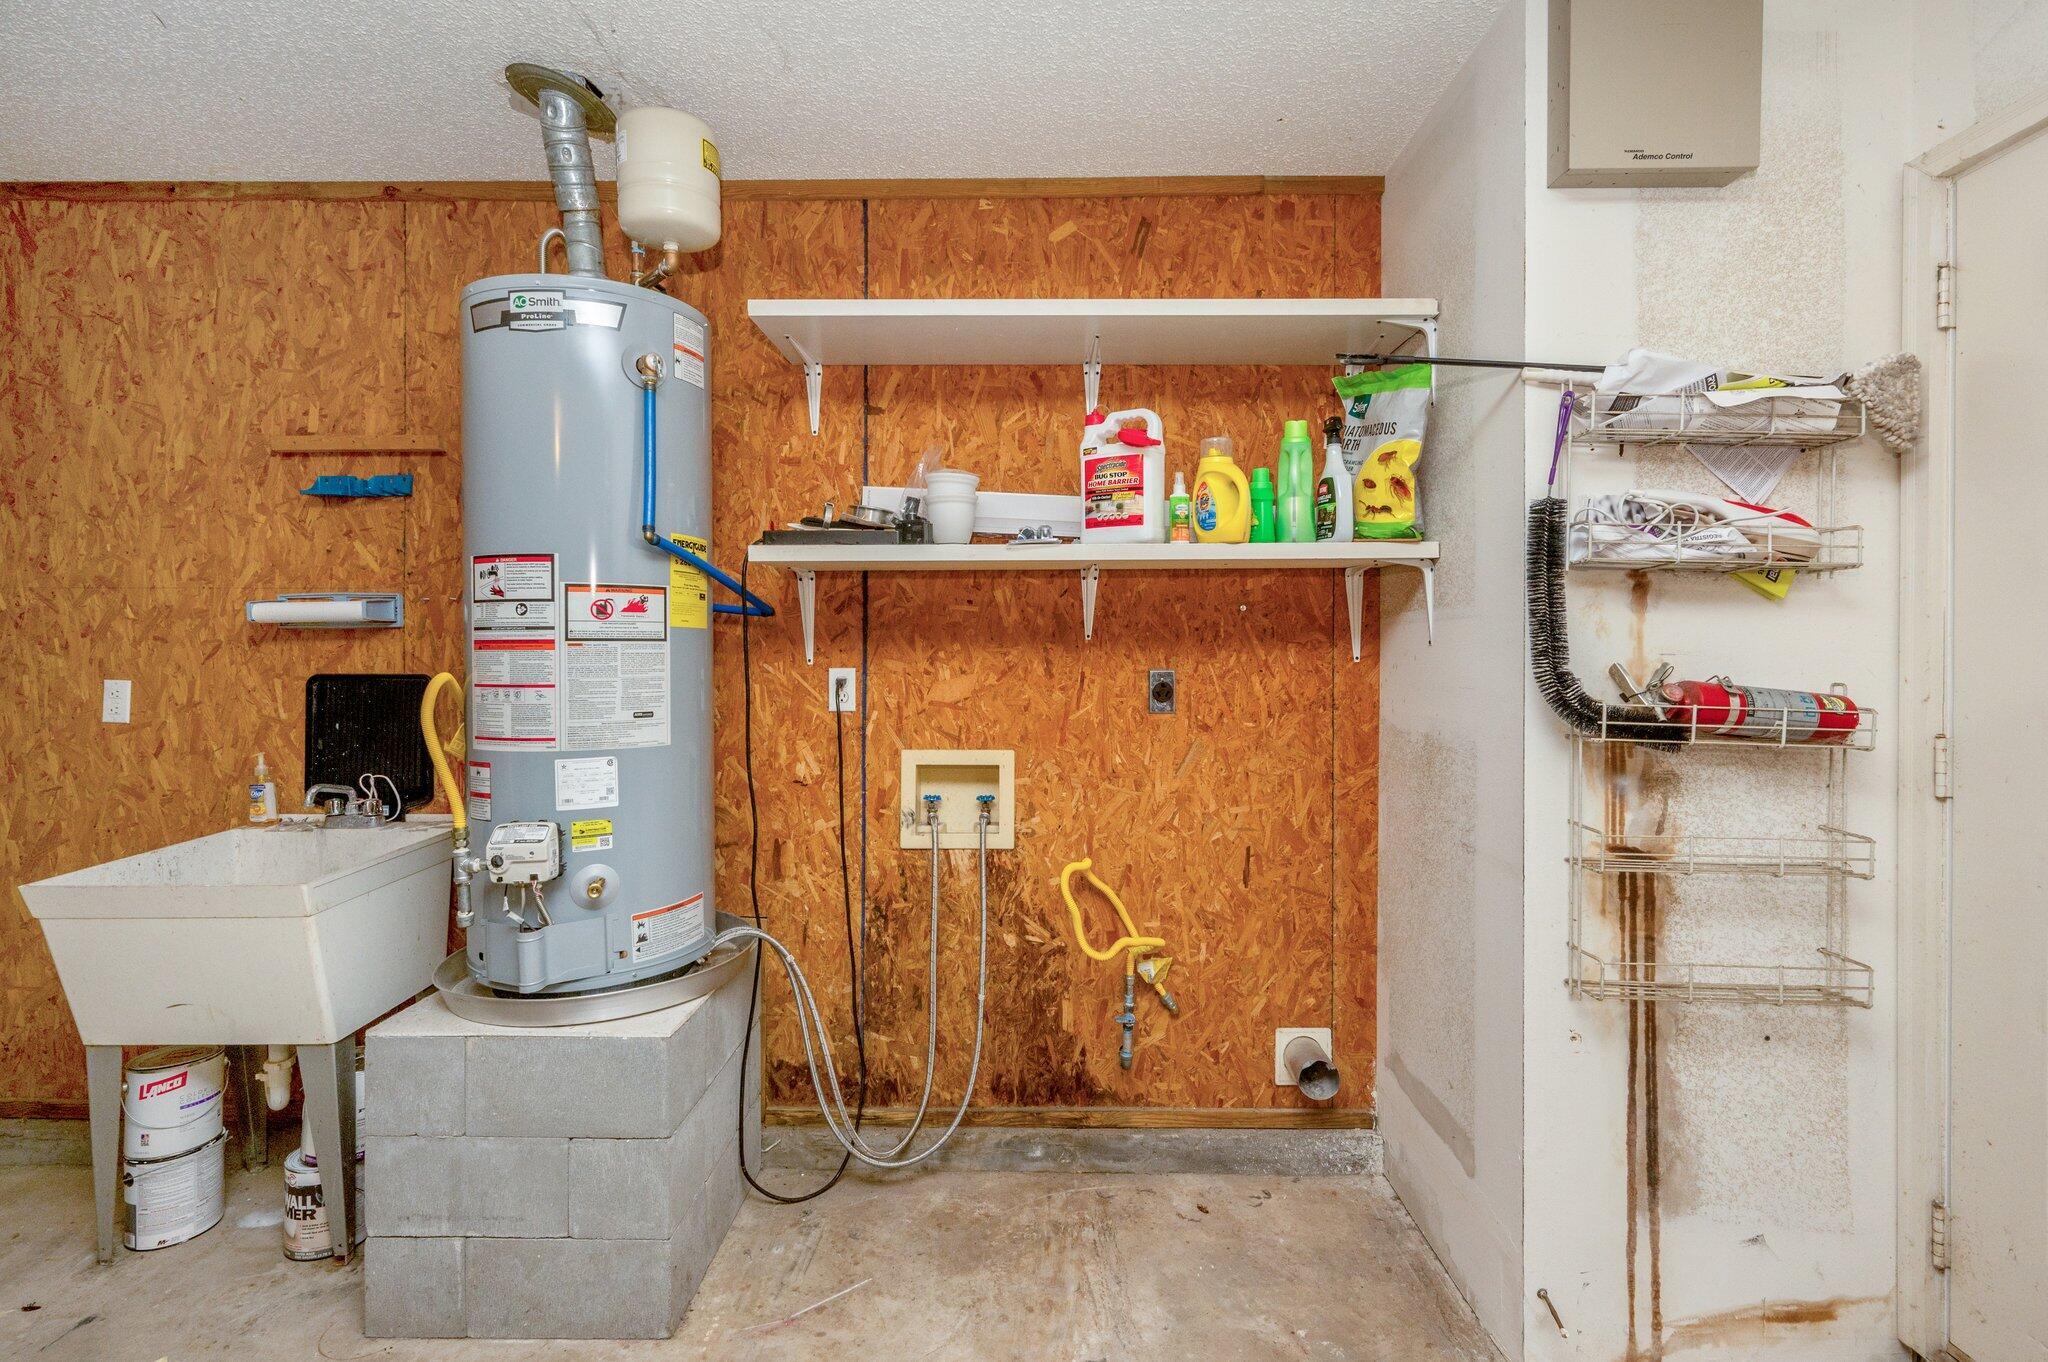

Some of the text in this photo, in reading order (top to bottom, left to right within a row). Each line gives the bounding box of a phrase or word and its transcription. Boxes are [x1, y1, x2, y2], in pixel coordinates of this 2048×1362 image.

[528, 296, 560, 306] Smith
[1094, 471, 1127, 480] BUG STOP
[1088, 477, 1139, 488] HOME BARRIER
[142, 1074, 184, 1099] LANCO
